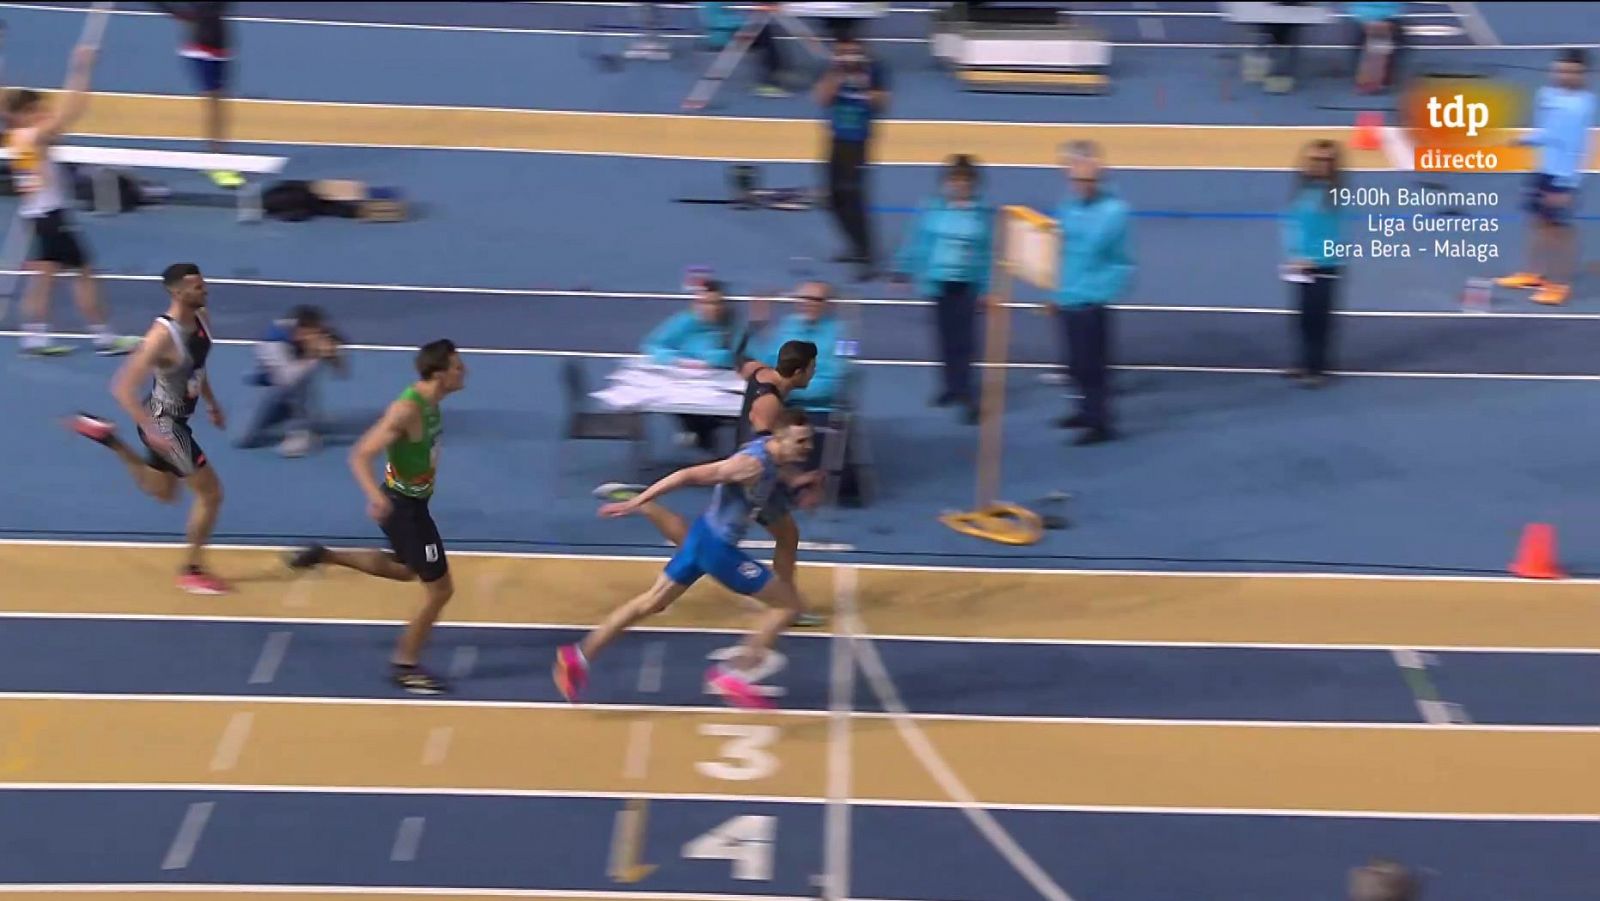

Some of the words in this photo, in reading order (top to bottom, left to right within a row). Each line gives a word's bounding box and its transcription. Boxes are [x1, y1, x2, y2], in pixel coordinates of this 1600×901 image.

[704, 645, 788, 697] 2
[695, 723, 781, 781] 3
[681, 815, 778, 881] 4
